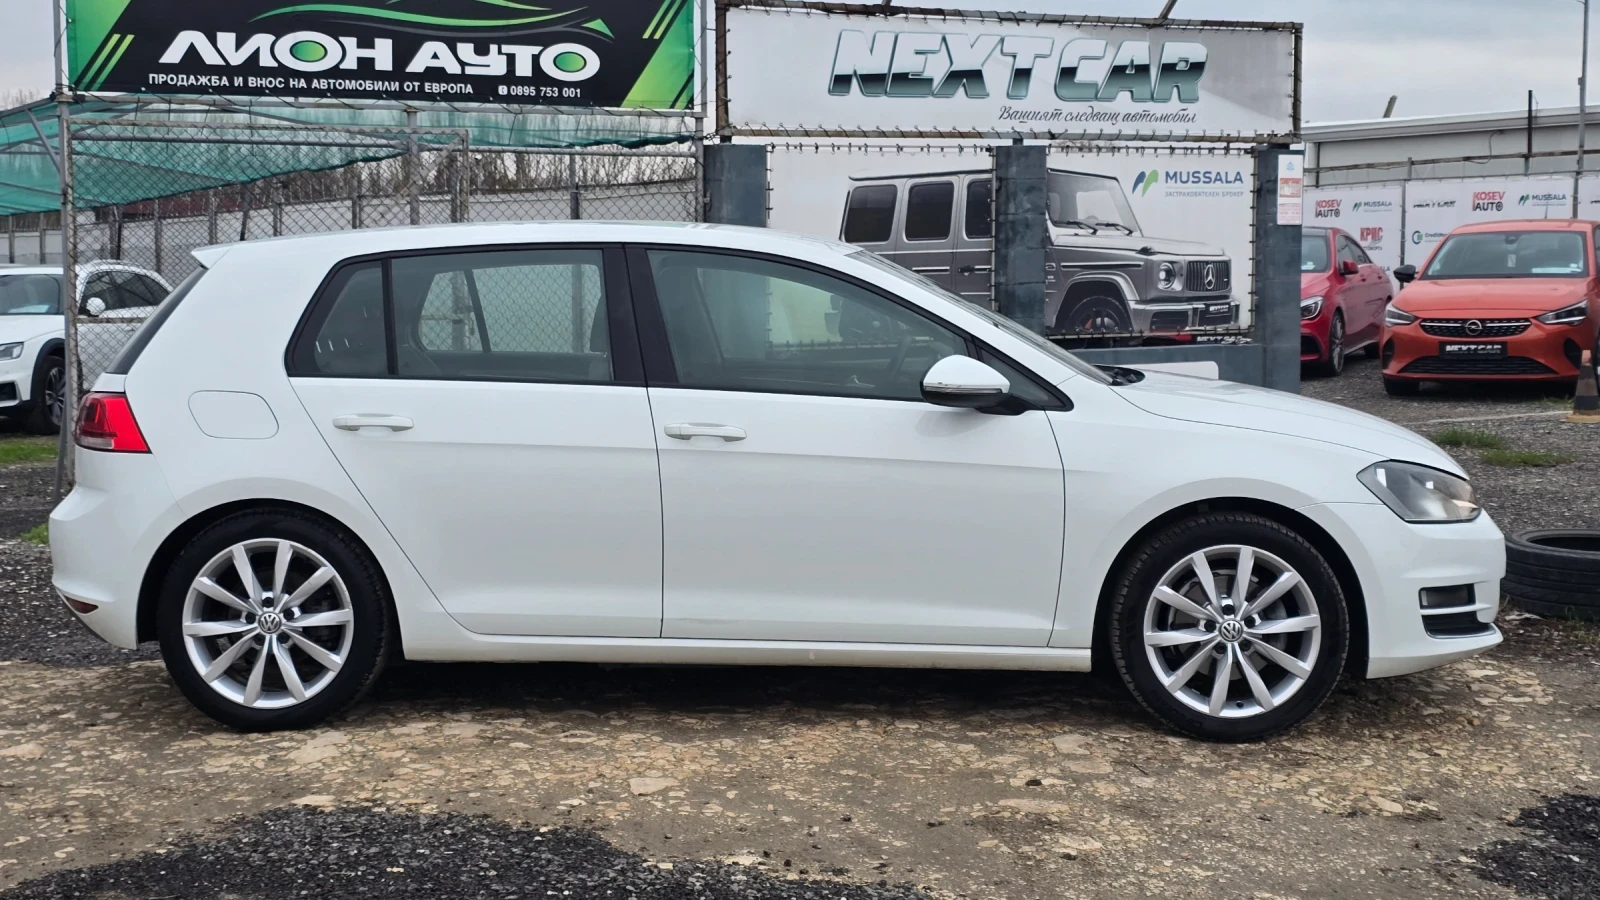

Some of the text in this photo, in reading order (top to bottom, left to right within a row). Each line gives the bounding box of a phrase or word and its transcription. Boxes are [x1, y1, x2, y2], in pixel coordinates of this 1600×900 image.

[158, 30, 601, 82] ЛИОН АУТО
[148, 73, 474, 94] ПРОДАЖБА И ВНОС НА АВТОМОБИЛИ ОТ ЕВРОПА
[510, 85, 581, 98] 0895 753 001
[998, 105, 1198, 126] Вашият следващ автомобил
[1164, 170, 1244, 185] MUSSALA
[1472, 191, 1506, 201] KOSEV
[1531, 193, 1567, 202] MUSSALA
[1315, 199, 1342, 209] KOSEV
[1363, 200, 1393, 208] MUSSALA
[1475, 201, 1503, 212] AUTO
[1317, 208, 1341, 219] AUTO
